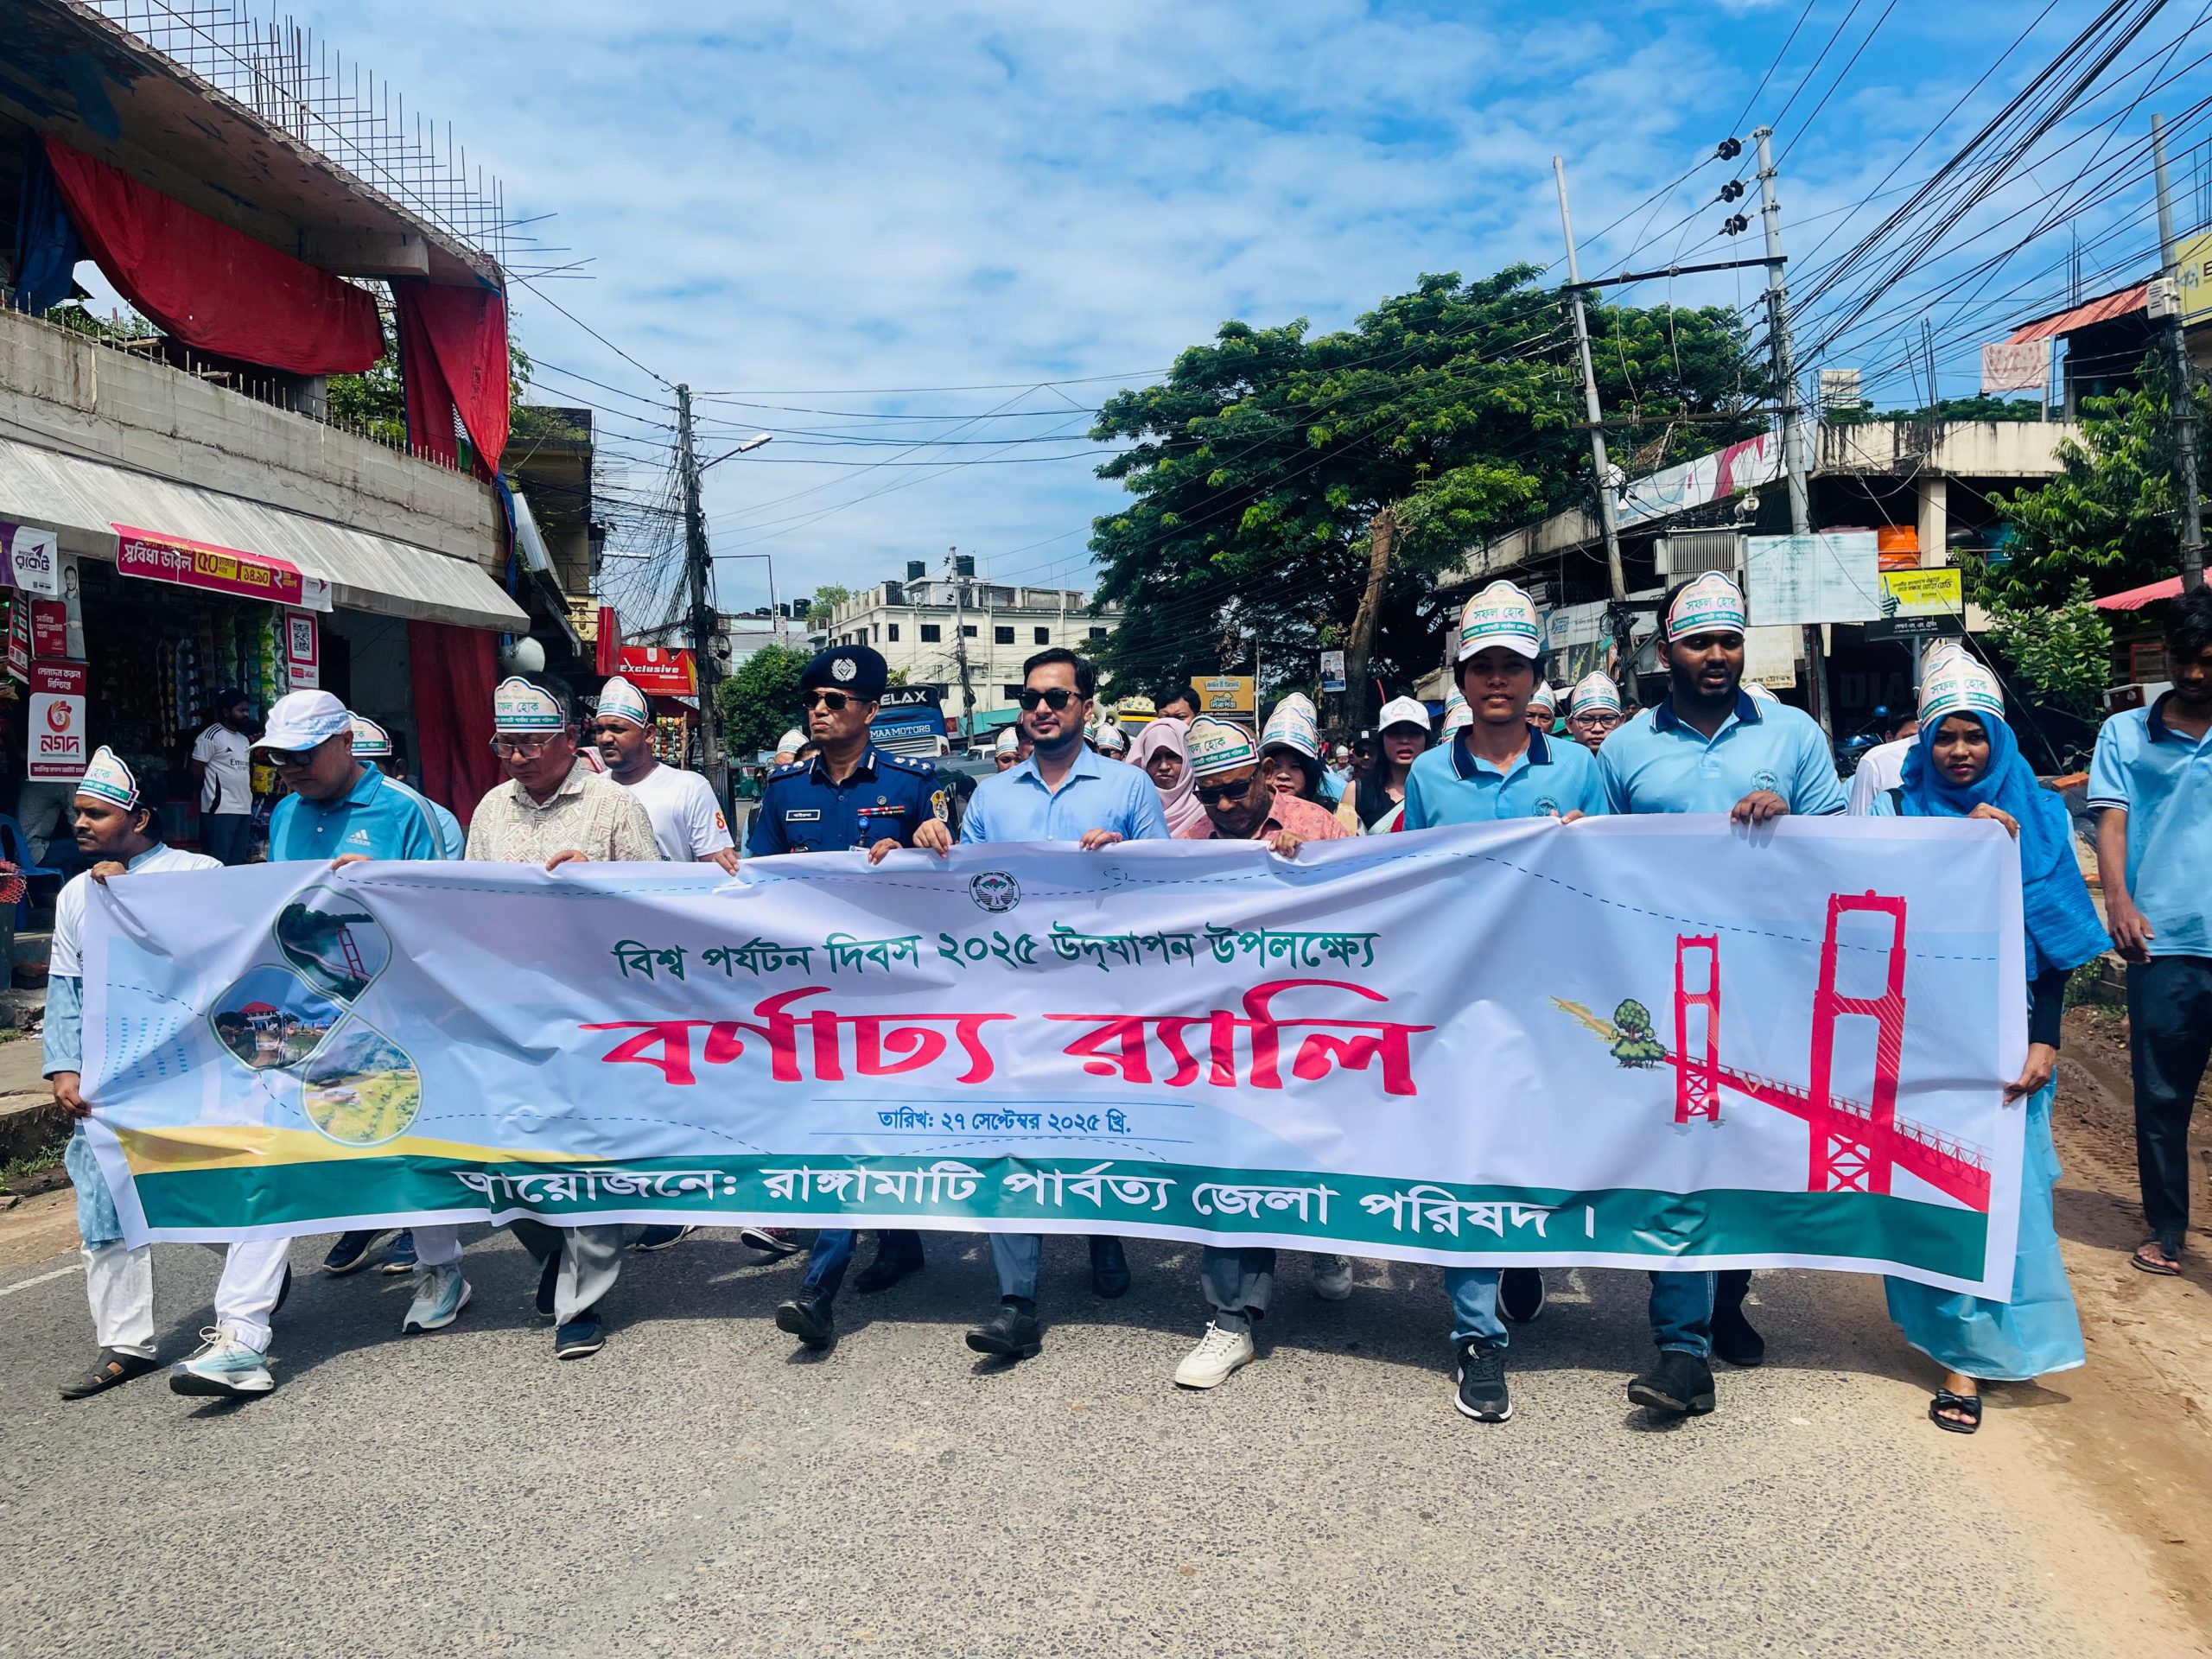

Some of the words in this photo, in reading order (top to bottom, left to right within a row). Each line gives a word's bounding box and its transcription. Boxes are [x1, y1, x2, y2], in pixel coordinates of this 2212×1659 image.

[124, 542, 159, 565] সুবিধা
[16, 555, 50, 571] রকেট
[197, 552, 218, 574] ৫০
[1685, 598, 1713, 612] সফল
[1717, 597, 1737, 608] হোক
[1473, 607, 1499, 621] সফল
[1503, 607, 1526, 620] হোক
[38, 667, 63, 677] লেনদেন
[63, 670, 81, 679] করুন
[620, 658, 679, 673] Exclusive
[1930, 680, 1957, 694] সফল
[880, 690, 927, 706] ELAX
[497, 702, 513, 713] ফল
[517, 702, 539, 714] হোক
[893, 724, 931, 736] MOTORS
[41, 734, 79, 753] নগদ
[1186, 742, 1202, 754] ফল
[1205, 736, 1225, 752] হোক
[614, 939, 689, 982] বিশ্ব
[702, 937, 816, 977] পর্যটন
[822, 932, 924, 974] দিবস
[938, 931, 1039, 969] ২০২৫
[1202, 921, 1382, 969] উপলক্ষ্যে
[577, 986, 1017, 1085] বর্ণাঢ্য
[1042, 979, 1437, 1096] র‍্যালি
[877, 1106, 934, 1130] তারিখ:
[941, 1112, 965, 1134] ২৭
[971, 1107, 1043, 1130] সেপ্টেম্বর
[1047, 1113, 1102, 1135] ২০২৫
[1105, 1108, 1132, 1135] খ্রি.
[759, 1160, 987, 1205] রাঙ্গামাটি
[1002, 1162, 1178, 1211] পার্বত্য
[1192, 1182, 1342, 1226] জেলা
[1359, 1185, 1561, 1239] পরিষদ
